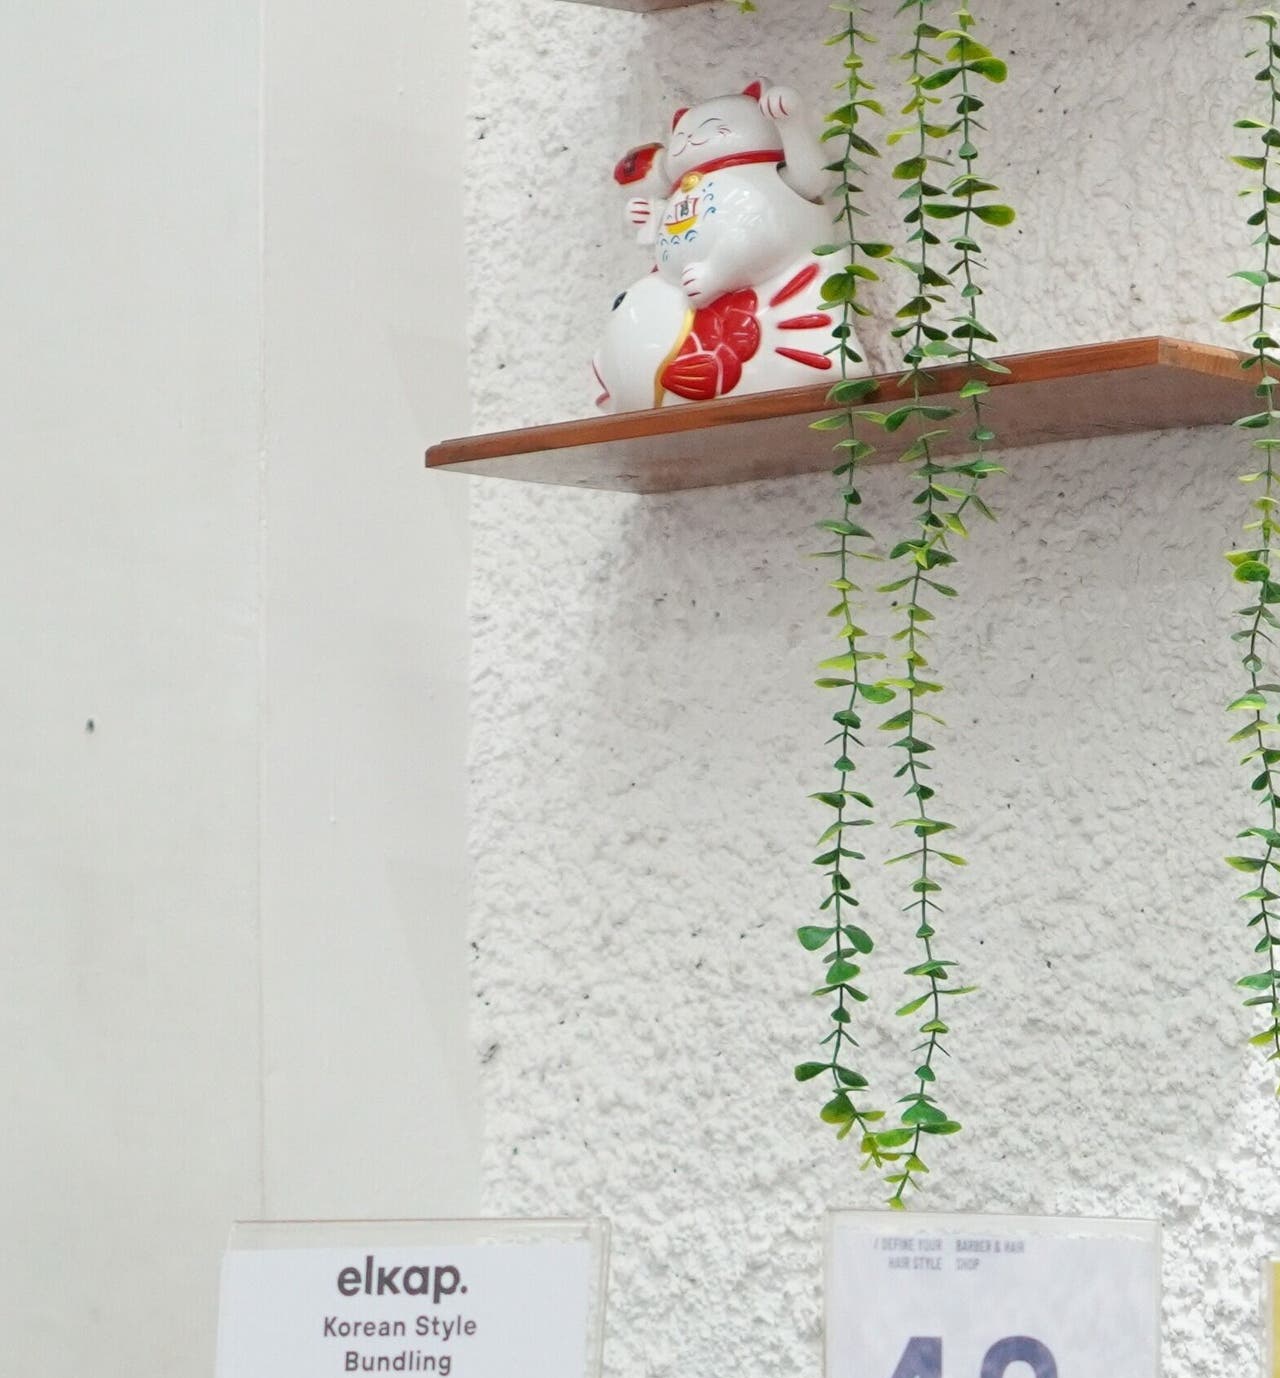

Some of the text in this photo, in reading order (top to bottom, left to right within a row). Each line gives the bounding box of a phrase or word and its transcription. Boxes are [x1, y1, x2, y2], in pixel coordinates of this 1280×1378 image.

[323, 1315, 478, 1341] Korean Style
[345, 1351, 452, 1376] Bundling
